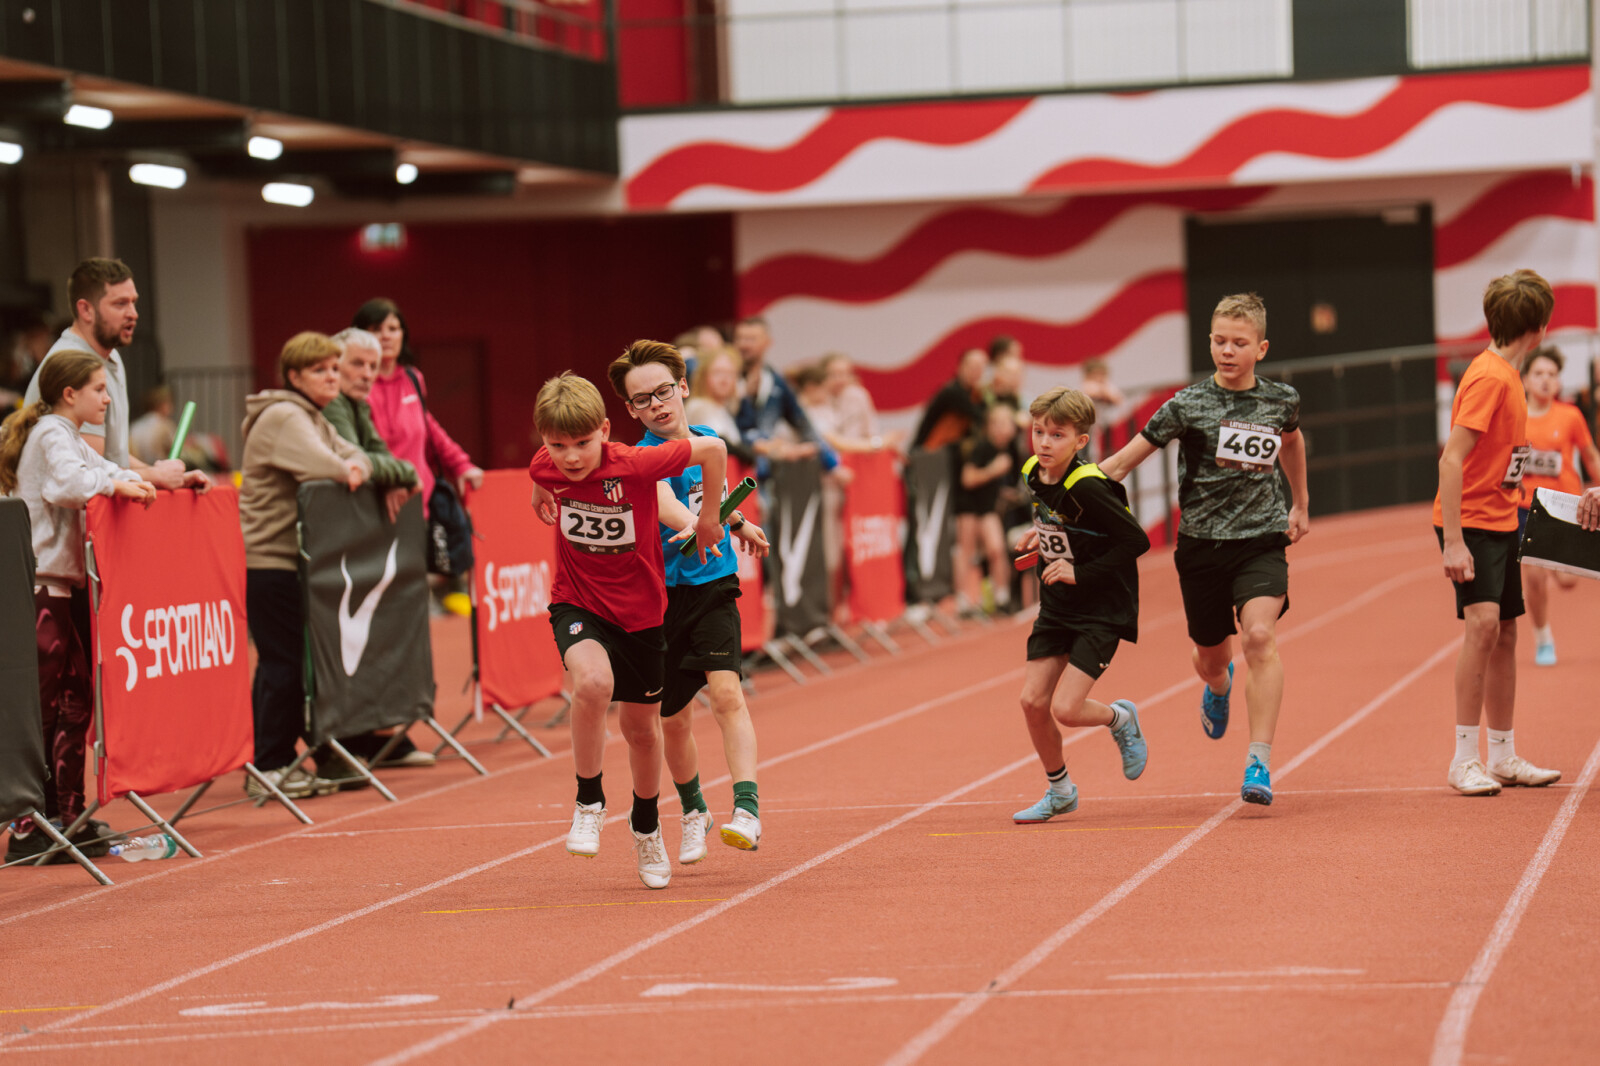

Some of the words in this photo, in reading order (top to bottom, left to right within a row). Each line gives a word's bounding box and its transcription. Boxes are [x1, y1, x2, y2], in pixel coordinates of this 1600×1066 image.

[1223, 432, 1277, 459] 469
[567, 512, 626, 541] 239
[144, 599, 235, 679] SPORTLAND
